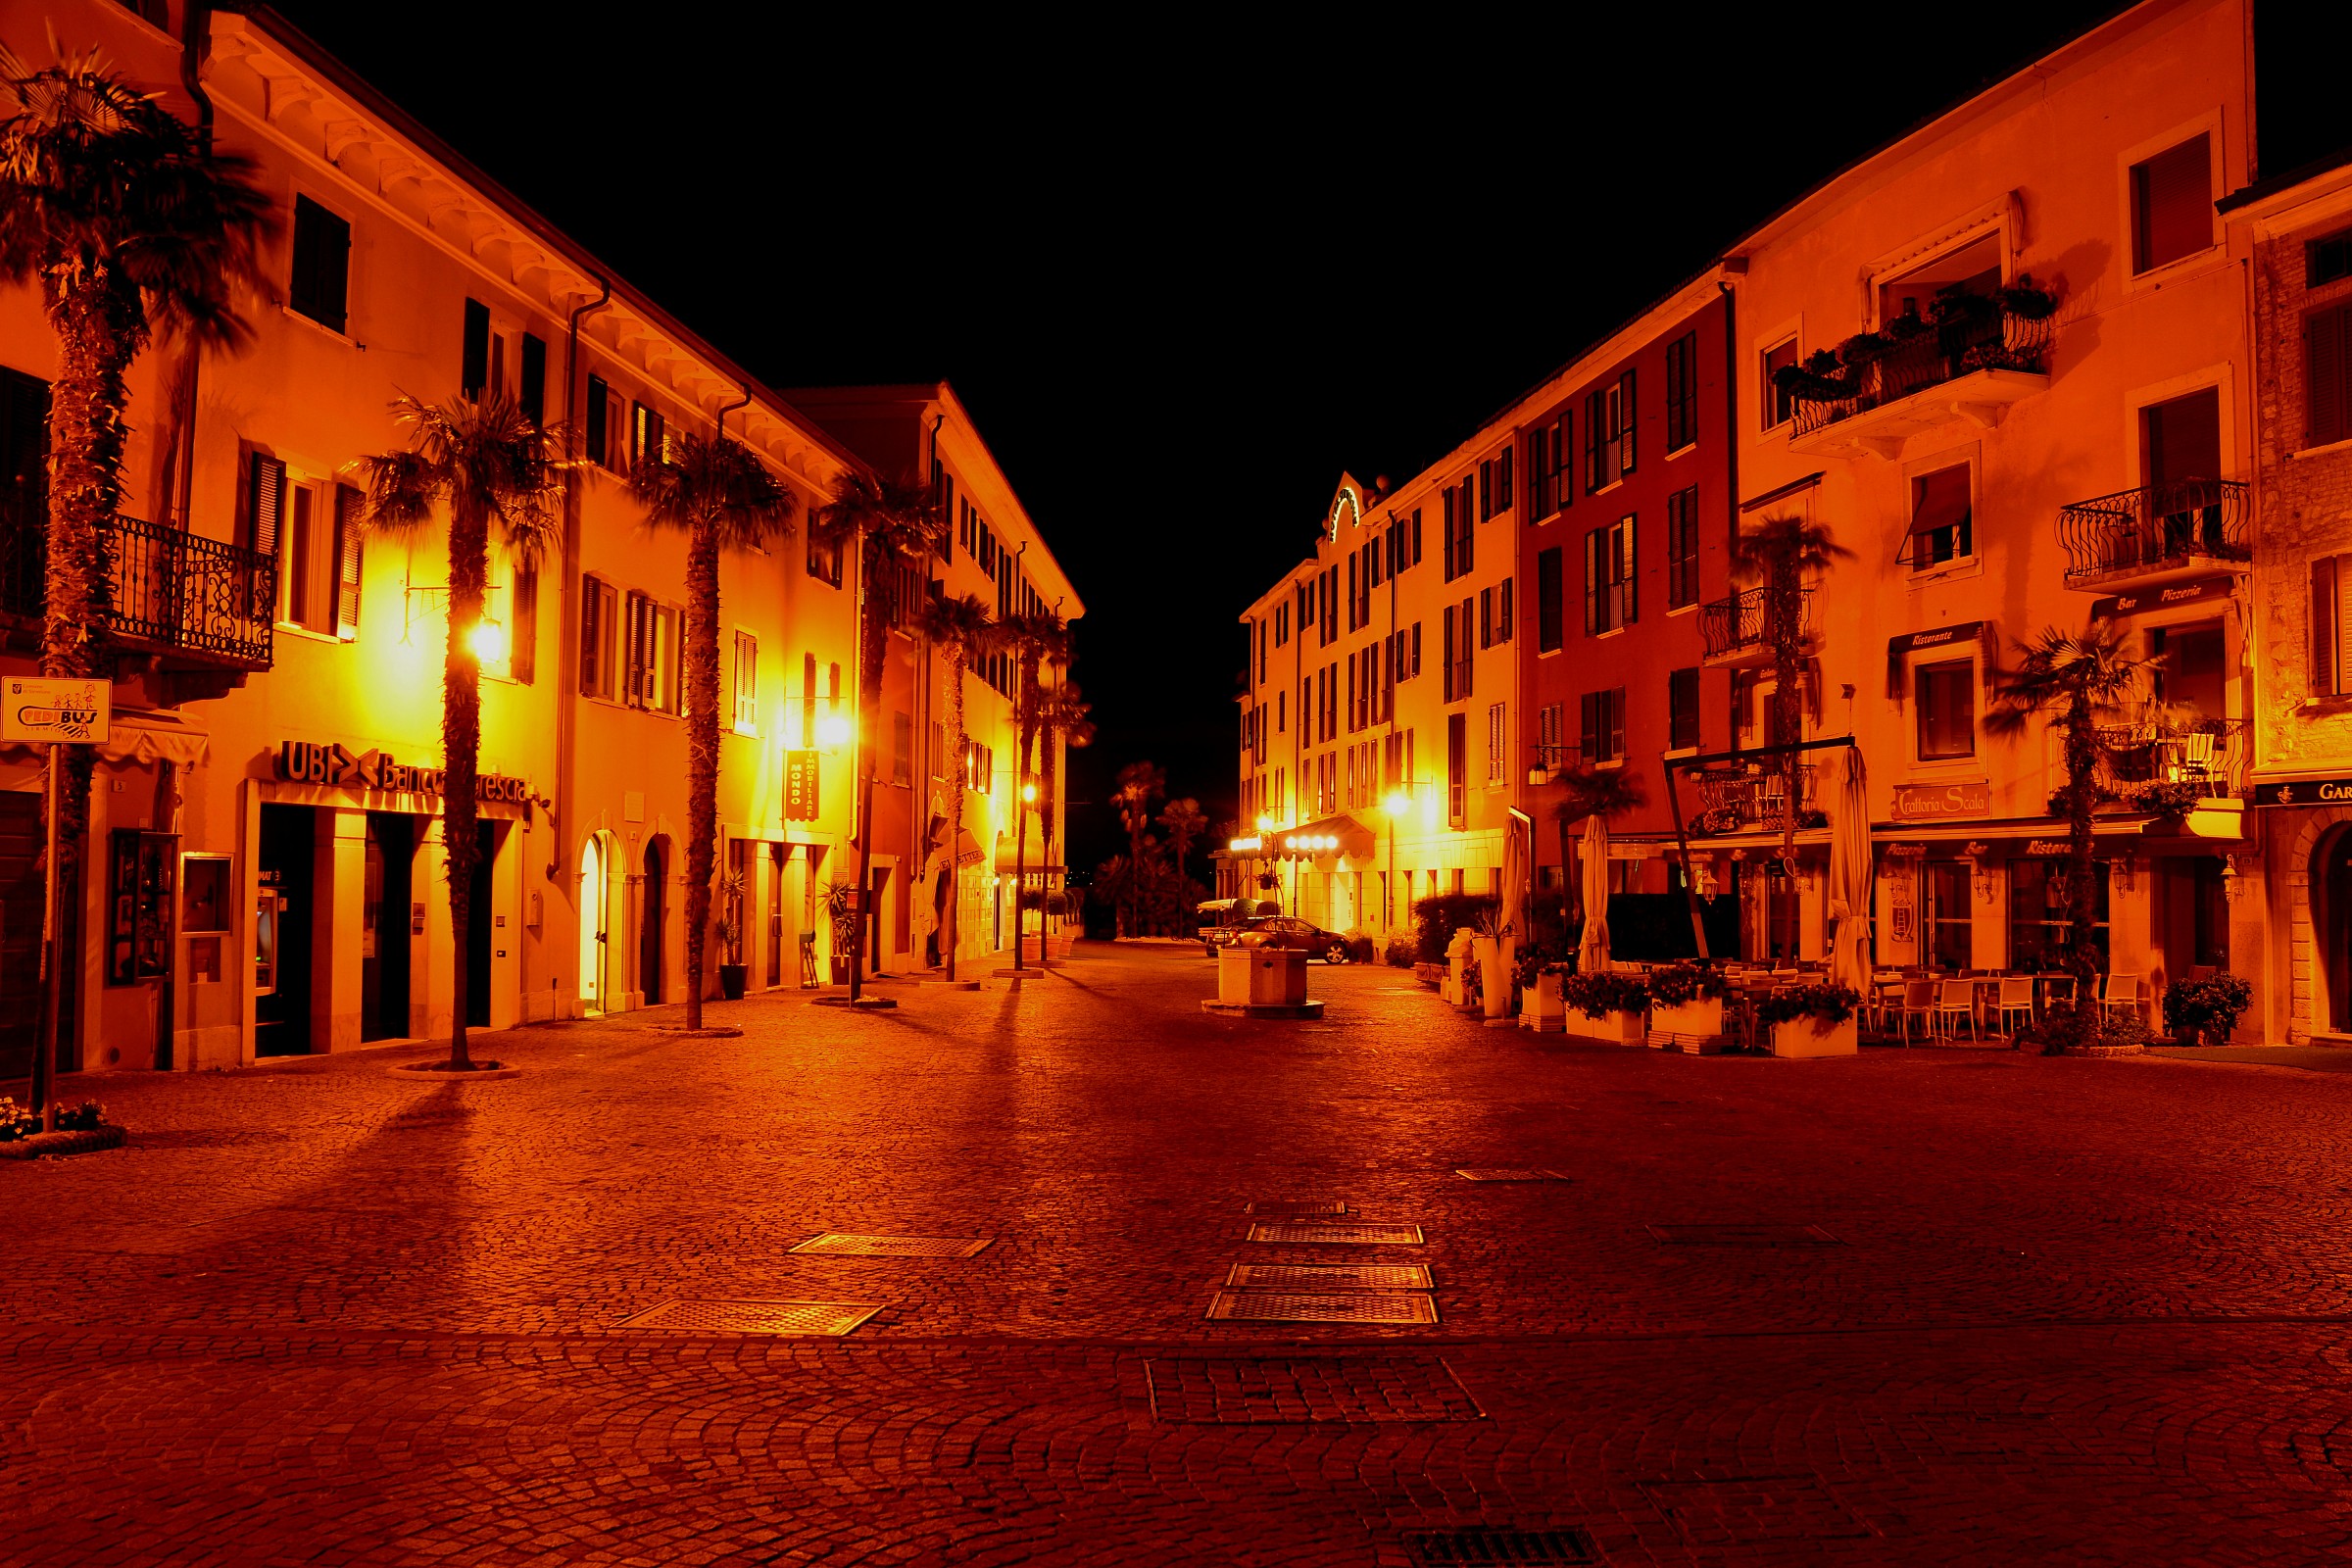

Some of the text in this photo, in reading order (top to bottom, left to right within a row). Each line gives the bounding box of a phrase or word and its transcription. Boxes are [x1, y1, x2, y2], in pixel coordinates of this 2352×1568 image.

[2118, 585, 2201, 610] Bar Pizzeria
[1912, 631, 1952, 646] Ristorante
[281, 741, 333, 784] UBI
[474, 773, 526, 802] rescia
[791, 764, 802, 805] MONDO
[807, 753, 815, 816] IMMOBILIARE
[1898, 787, 1984, 815] Trattoria Scala
